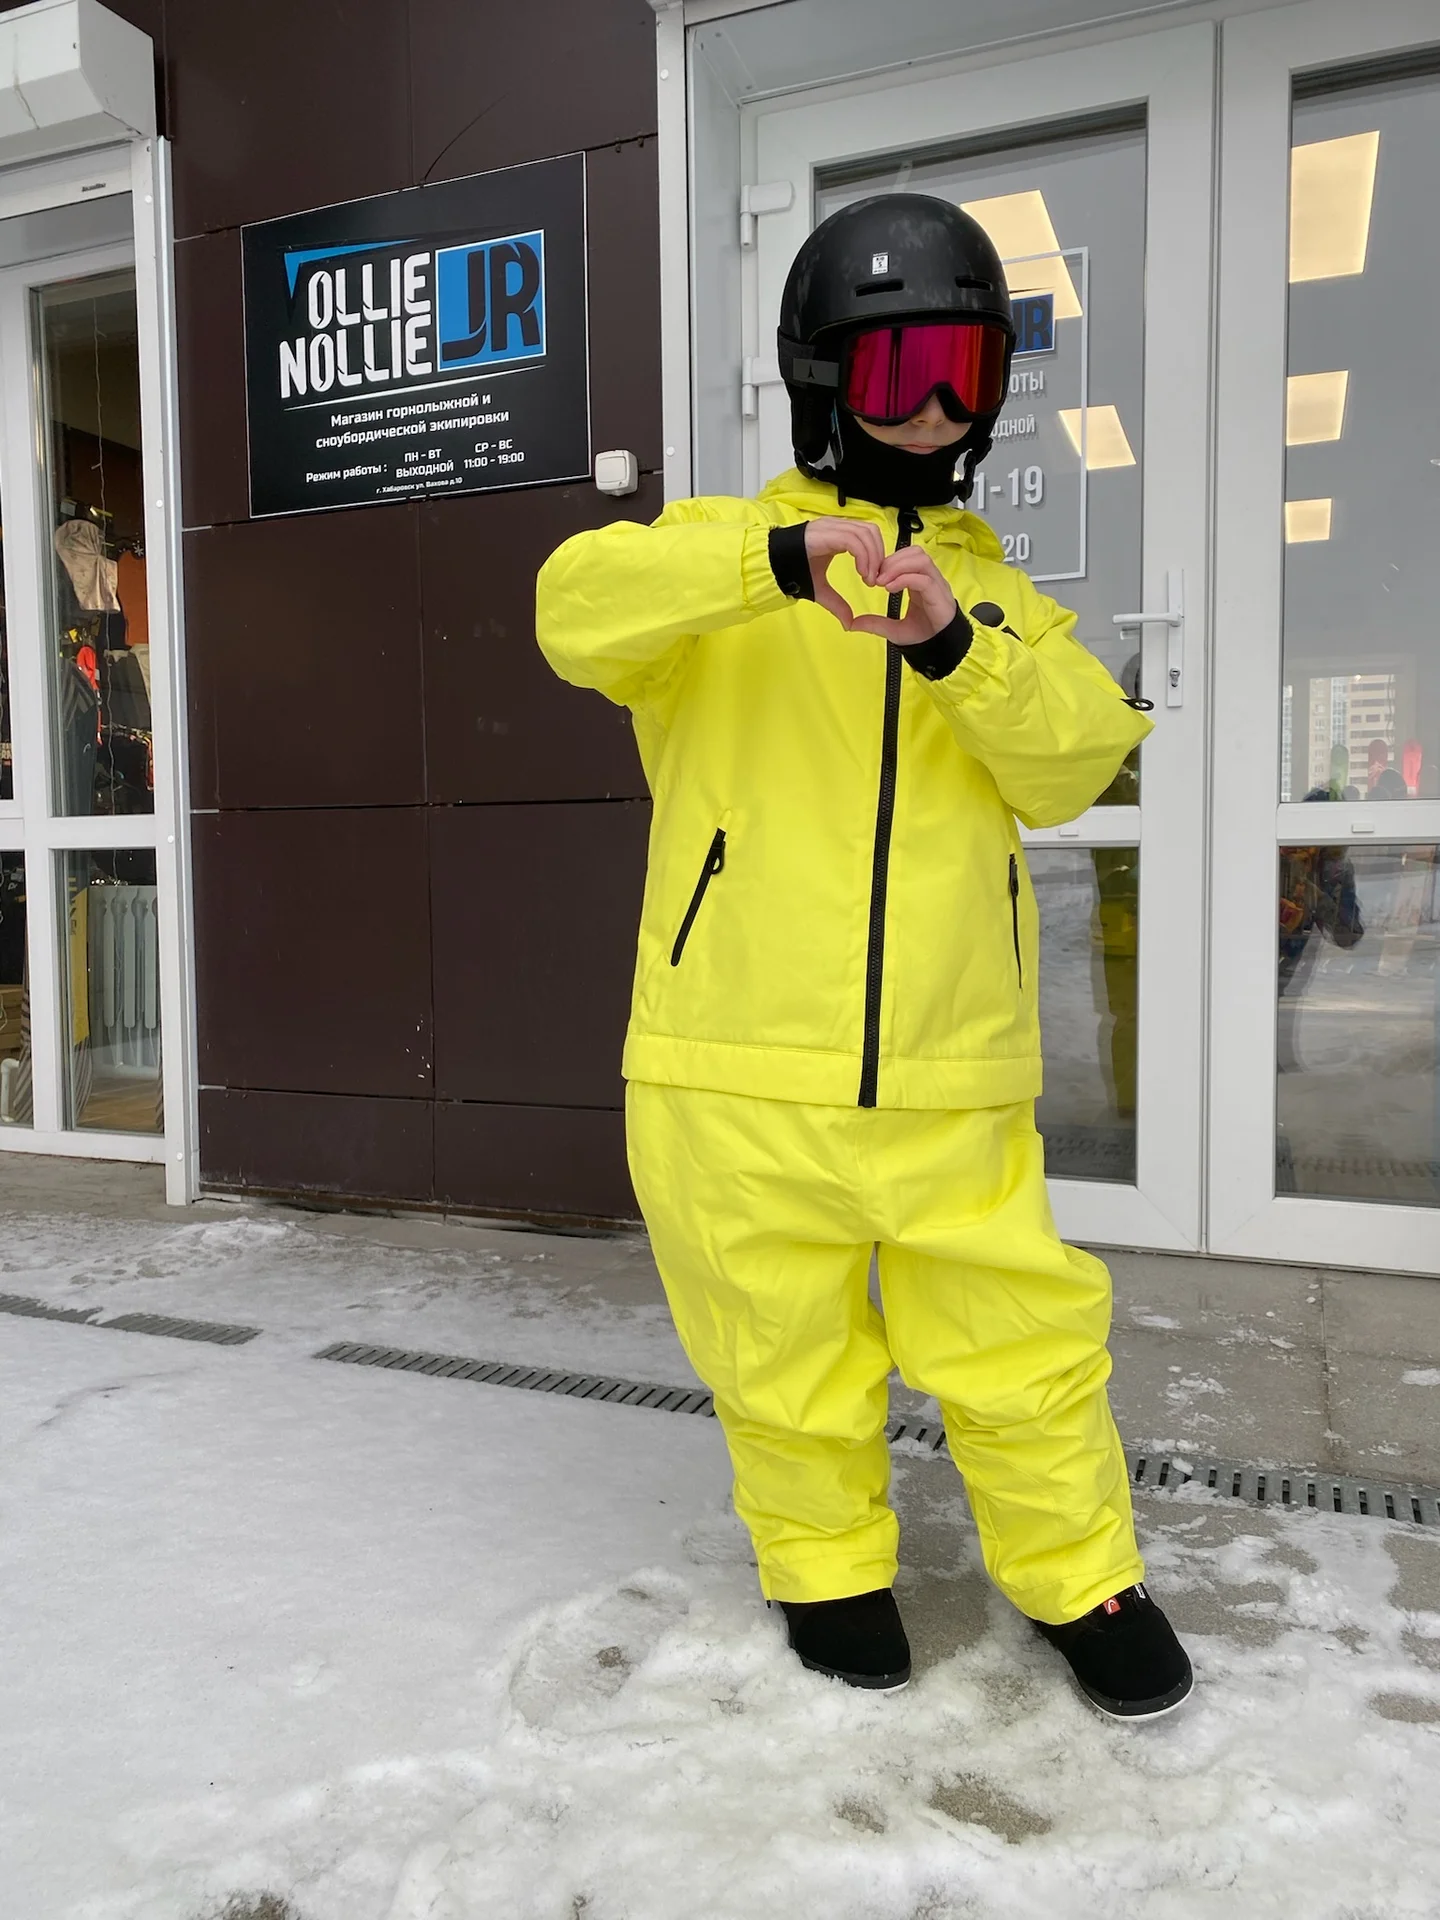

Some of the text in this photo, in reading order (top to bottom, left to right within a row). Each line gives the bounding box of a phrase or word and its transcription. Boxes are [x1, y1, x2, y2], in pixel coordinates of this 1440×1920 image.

[308, 252, 431, 329] OLLIE
[442, 241, 540, 362] JR
[280, 313, 432, 398] NOLLIE
[1009, 371, 1043, 393] ОТЫ
[331, 393, 491, 427] Магазин горнолыжной и
[316, 412, 509, 448] сноубордической экипировки
[990, 414, 1035, 438] ОДНОЙ
[404, 451, 419, 462] ПН
[428, 448, 442, 459] ВТ
[475, 442, 489, 453] СР
[499, 439, 513, 450] ВС
[396, 460, 454, 479] ВЫХОДНОЙ
[464, 457, 488, 469] 11:00
[498, 452, 525, 464] 19:00
[306, 469, 341, 483] Режим
[343, 465, 381, 479] работы
[958, 465, 1043, 510] 1-19
[1002, 533, 1030, 562] 20
